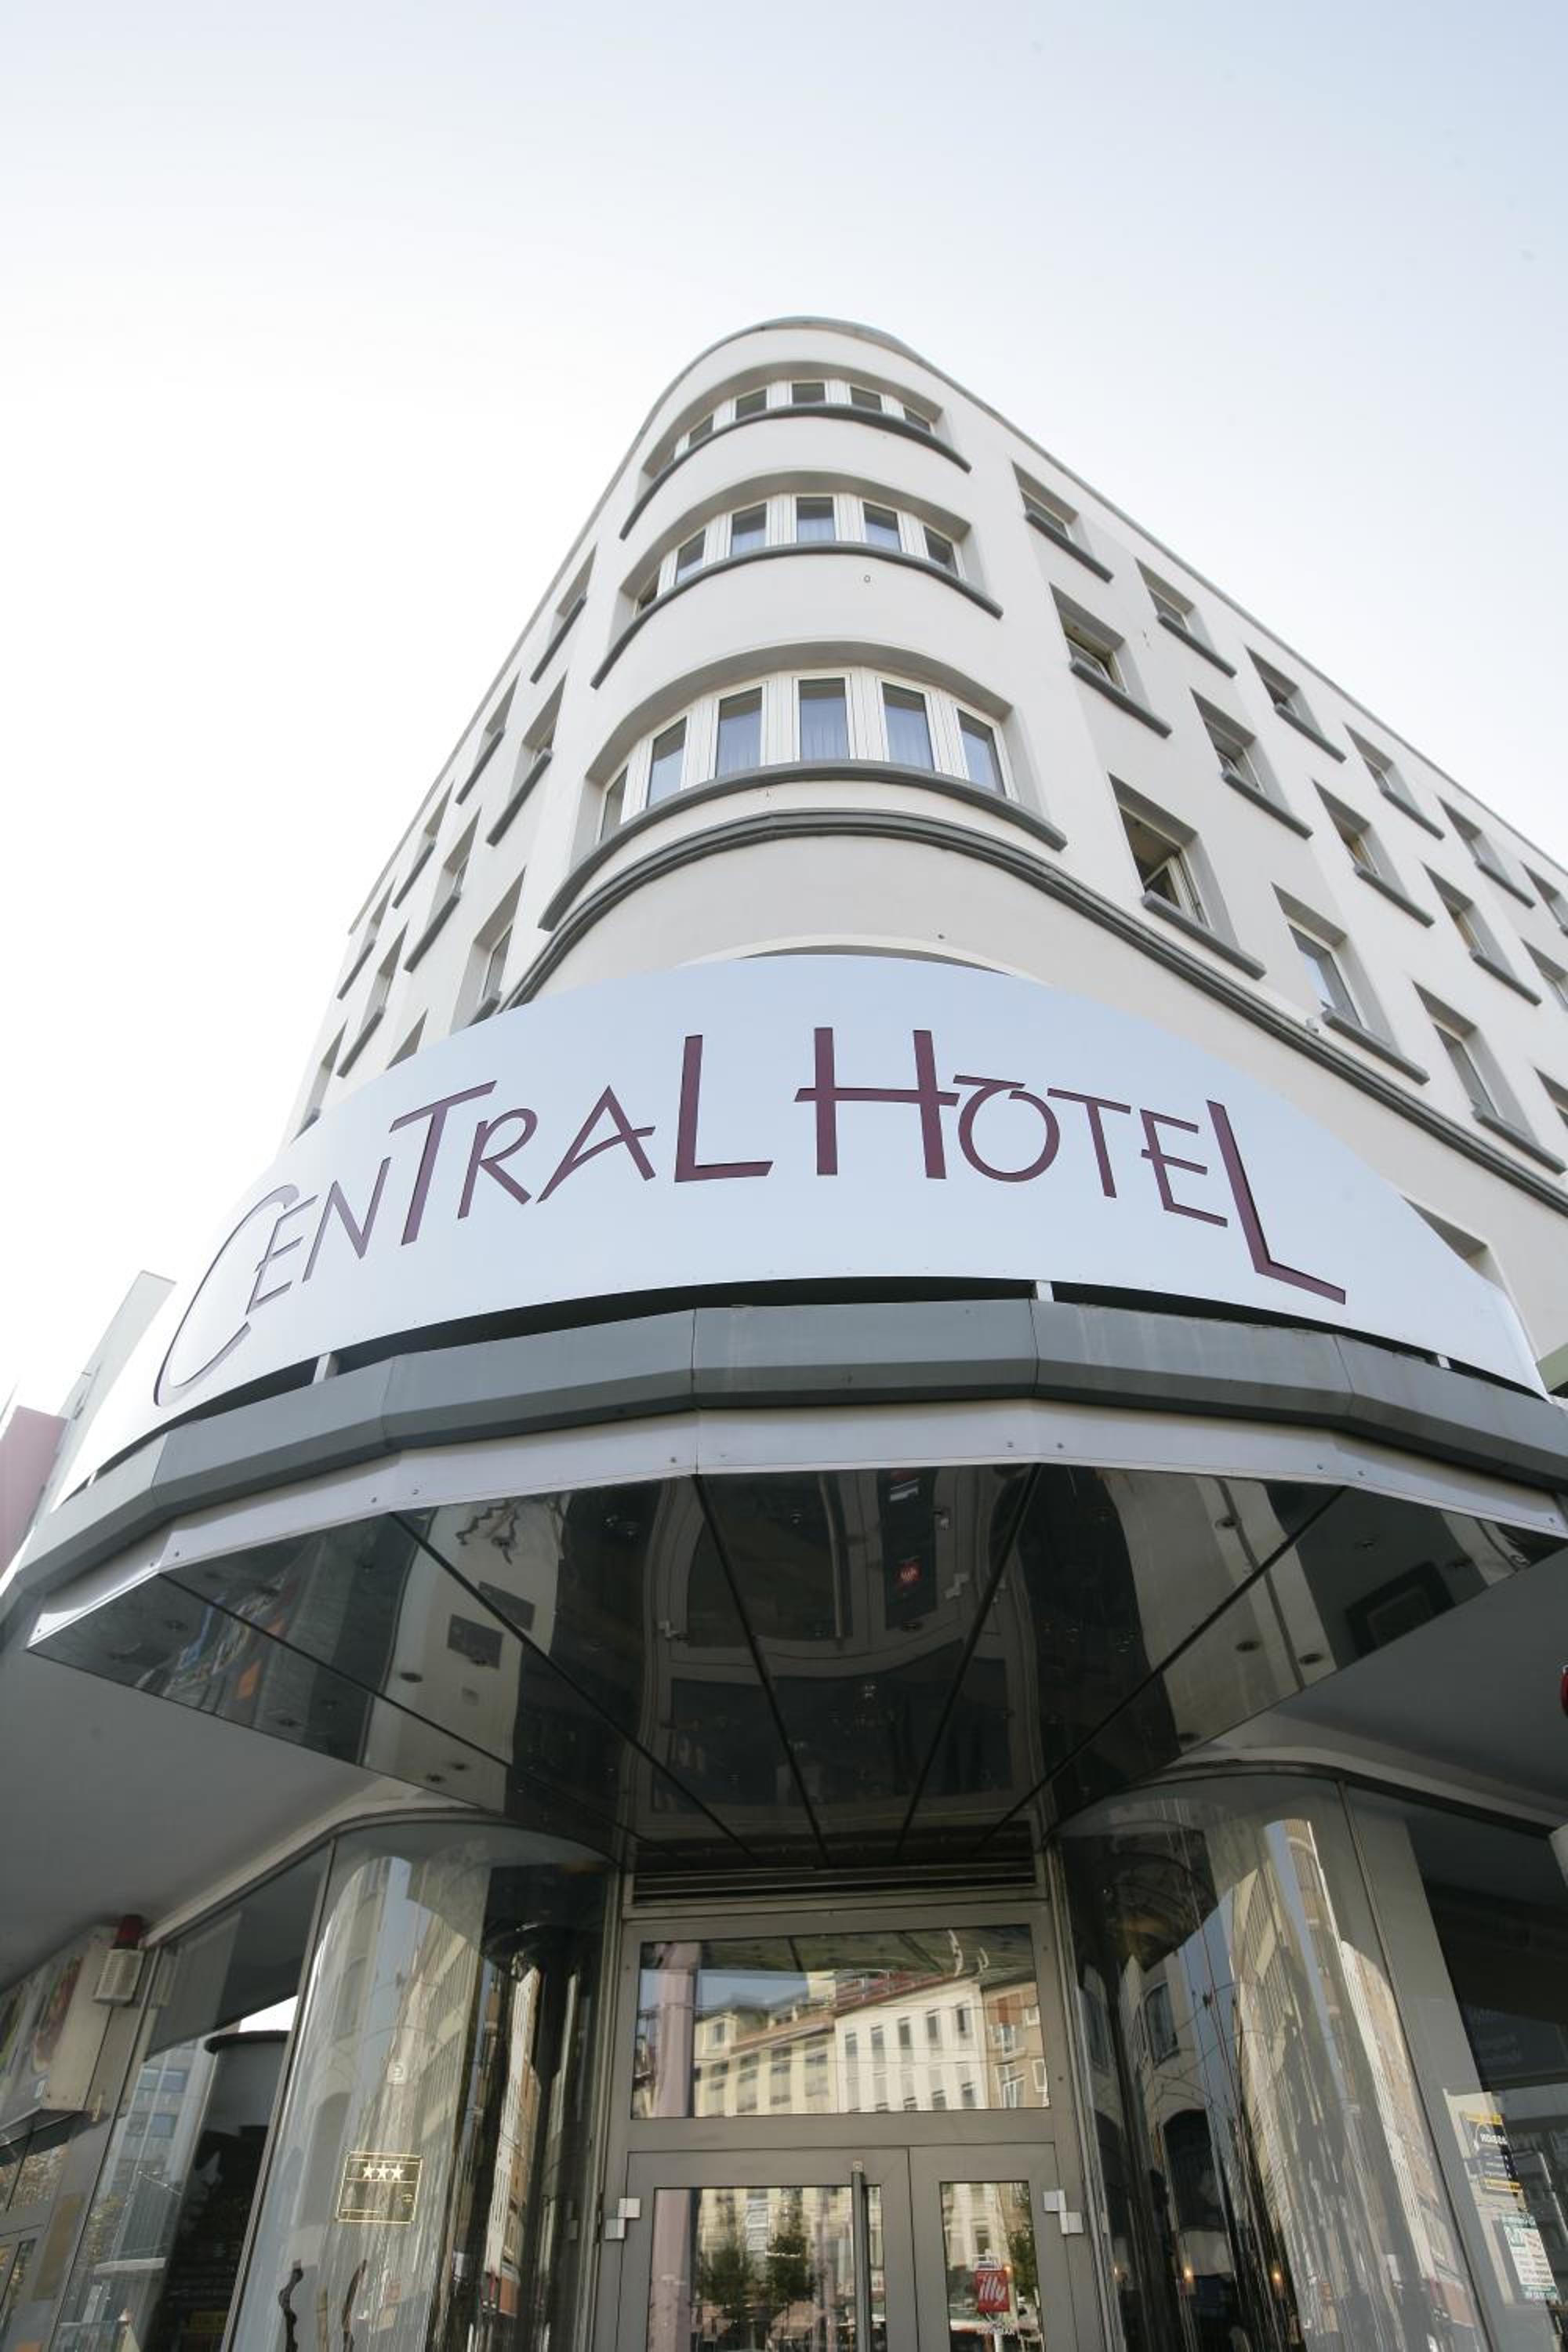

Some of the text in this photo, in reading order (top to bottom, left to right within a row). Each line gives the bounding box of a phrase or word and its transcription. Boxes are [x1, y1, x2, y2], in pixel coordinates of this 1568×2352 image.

[154, 1027, 1346, 1406] CENTRAL HOTEL
[979, 2275, 1007, 2307] illy
